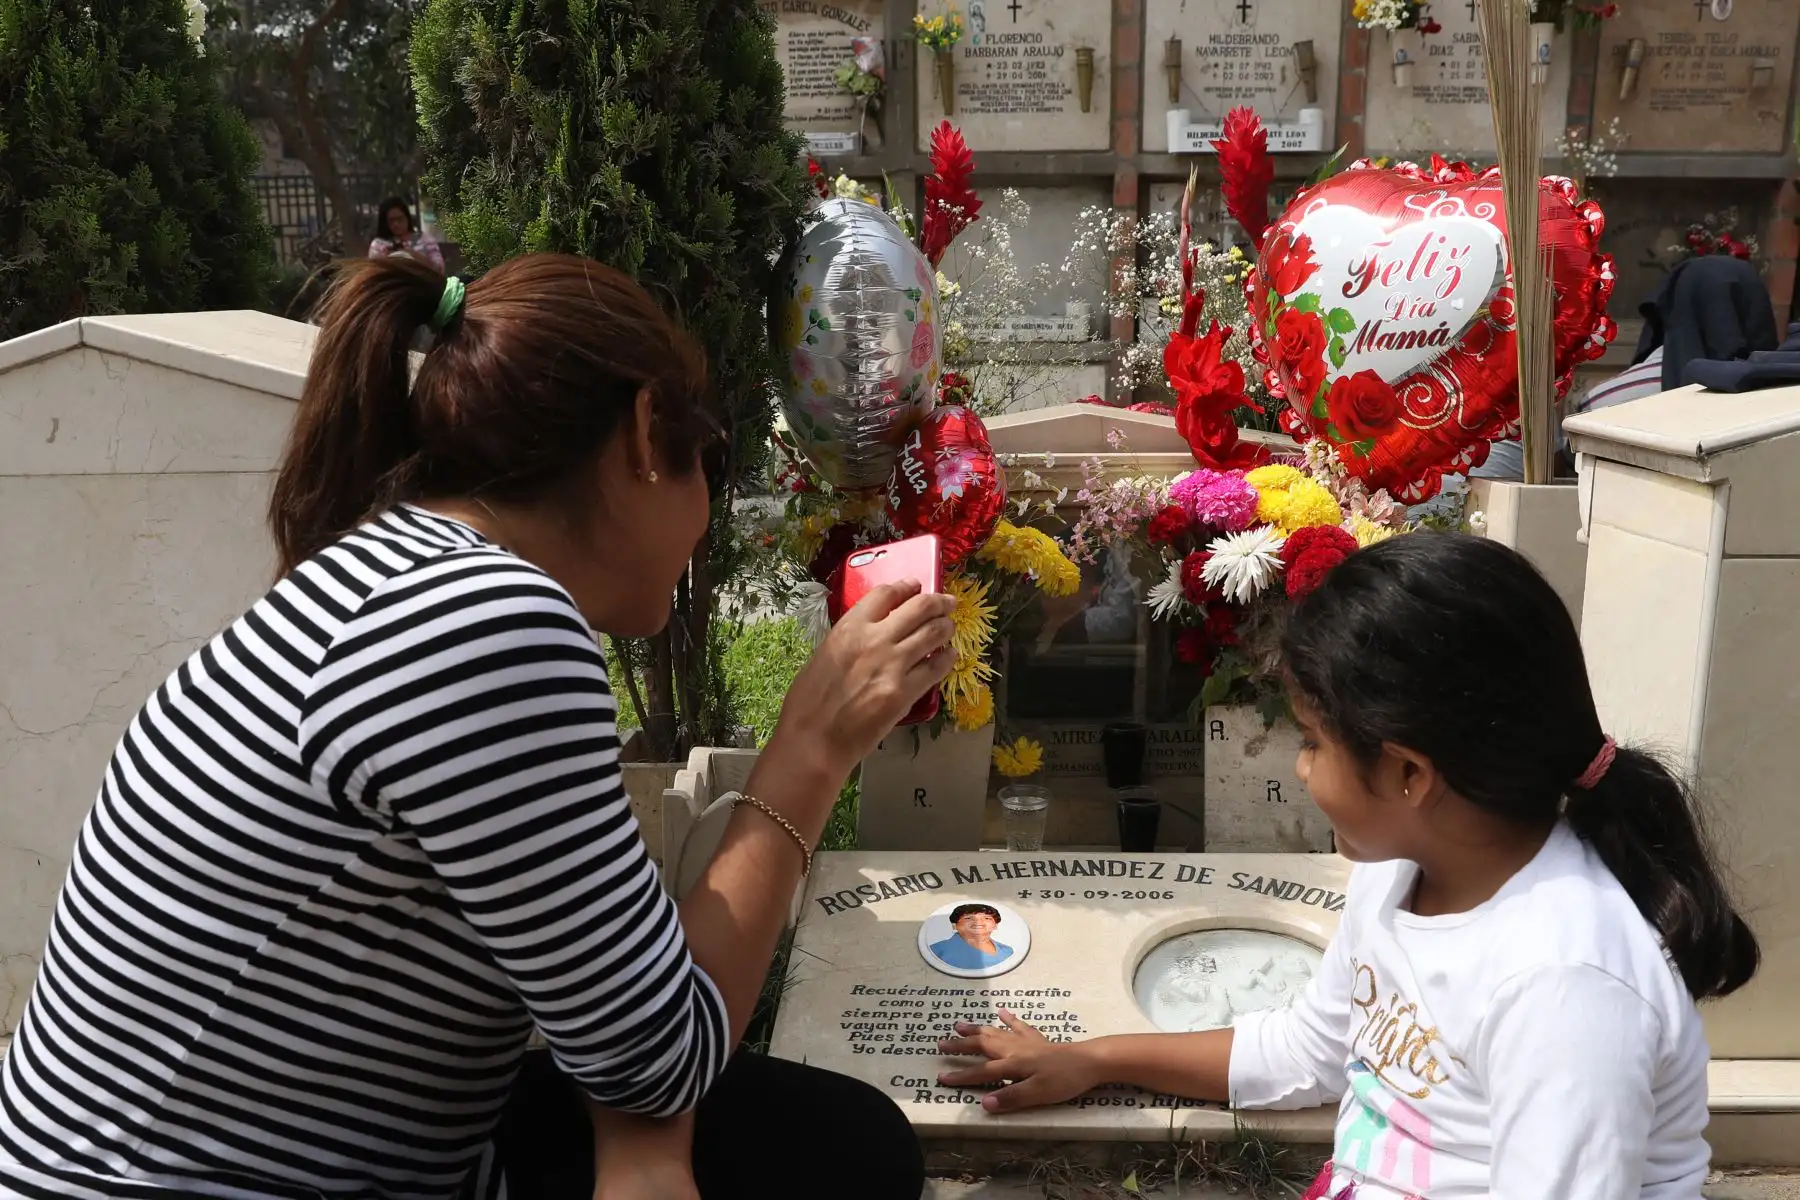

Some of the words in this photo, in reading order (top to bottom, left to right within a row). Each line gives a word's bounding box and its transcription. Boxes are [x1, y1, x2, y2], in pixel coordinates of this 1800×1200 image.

[782, 0, 818, 15] GARCIA
[821, 5, 872, 32] GONZALES
[985, 32, 1044, 45] FLORENCIO
[1208, 33, 1281, 45] HILDEBRANDO
[964, 46, 1019, 58] BARBARAN
[1022, 46, 1065, 58] ARAUJO
[1195, 46, 1253, 58] NAVARRETE
[1264, 46, 1295, 58] LEON
[1429, 44, 1455, 57] DIAZ
[1285, 131, 1307, 139] LEON
[1341, 231, 1472, 299] Feliz
[1384, 292, 1438, 322] Día
[1346, 319, 1453, 355] Mamá
[896, 429, 928, 495] Feliz
[913, 787, 933, 808] R.
[1265, 779, 1288, 803] R.
[814, 870, 944, 917] ROSARIO
[949, 865, 991, 885] M.
[991, 859, 1166, 880] HERNANDEZ
[1174, 863, 1217, 885] DE
[849, 984, 976, 997] Recuérdenme
[979, 988, 1011, 998] con
[1013, 987, 1072, 998] cariño
[878, 999, 925, 1008] como
[930, 999, 954, 1012] yo
[962, 998, 990, 1009] los
[840, 1009, 924, 1023] siempre
[927, 1010, 999, 1025] porque
[1021, 1011, 1079, 1022] donde
[840, 1022, 899, 1034] vayan
[904, 1023, 927, 1034] yo
[847, 1032, 895, 1043] Pues
[851, 1043, 876, 1056] Yo
[890, 1075, 929, 1089] Con
[1150, 1091, 1206, 1111] hijos
